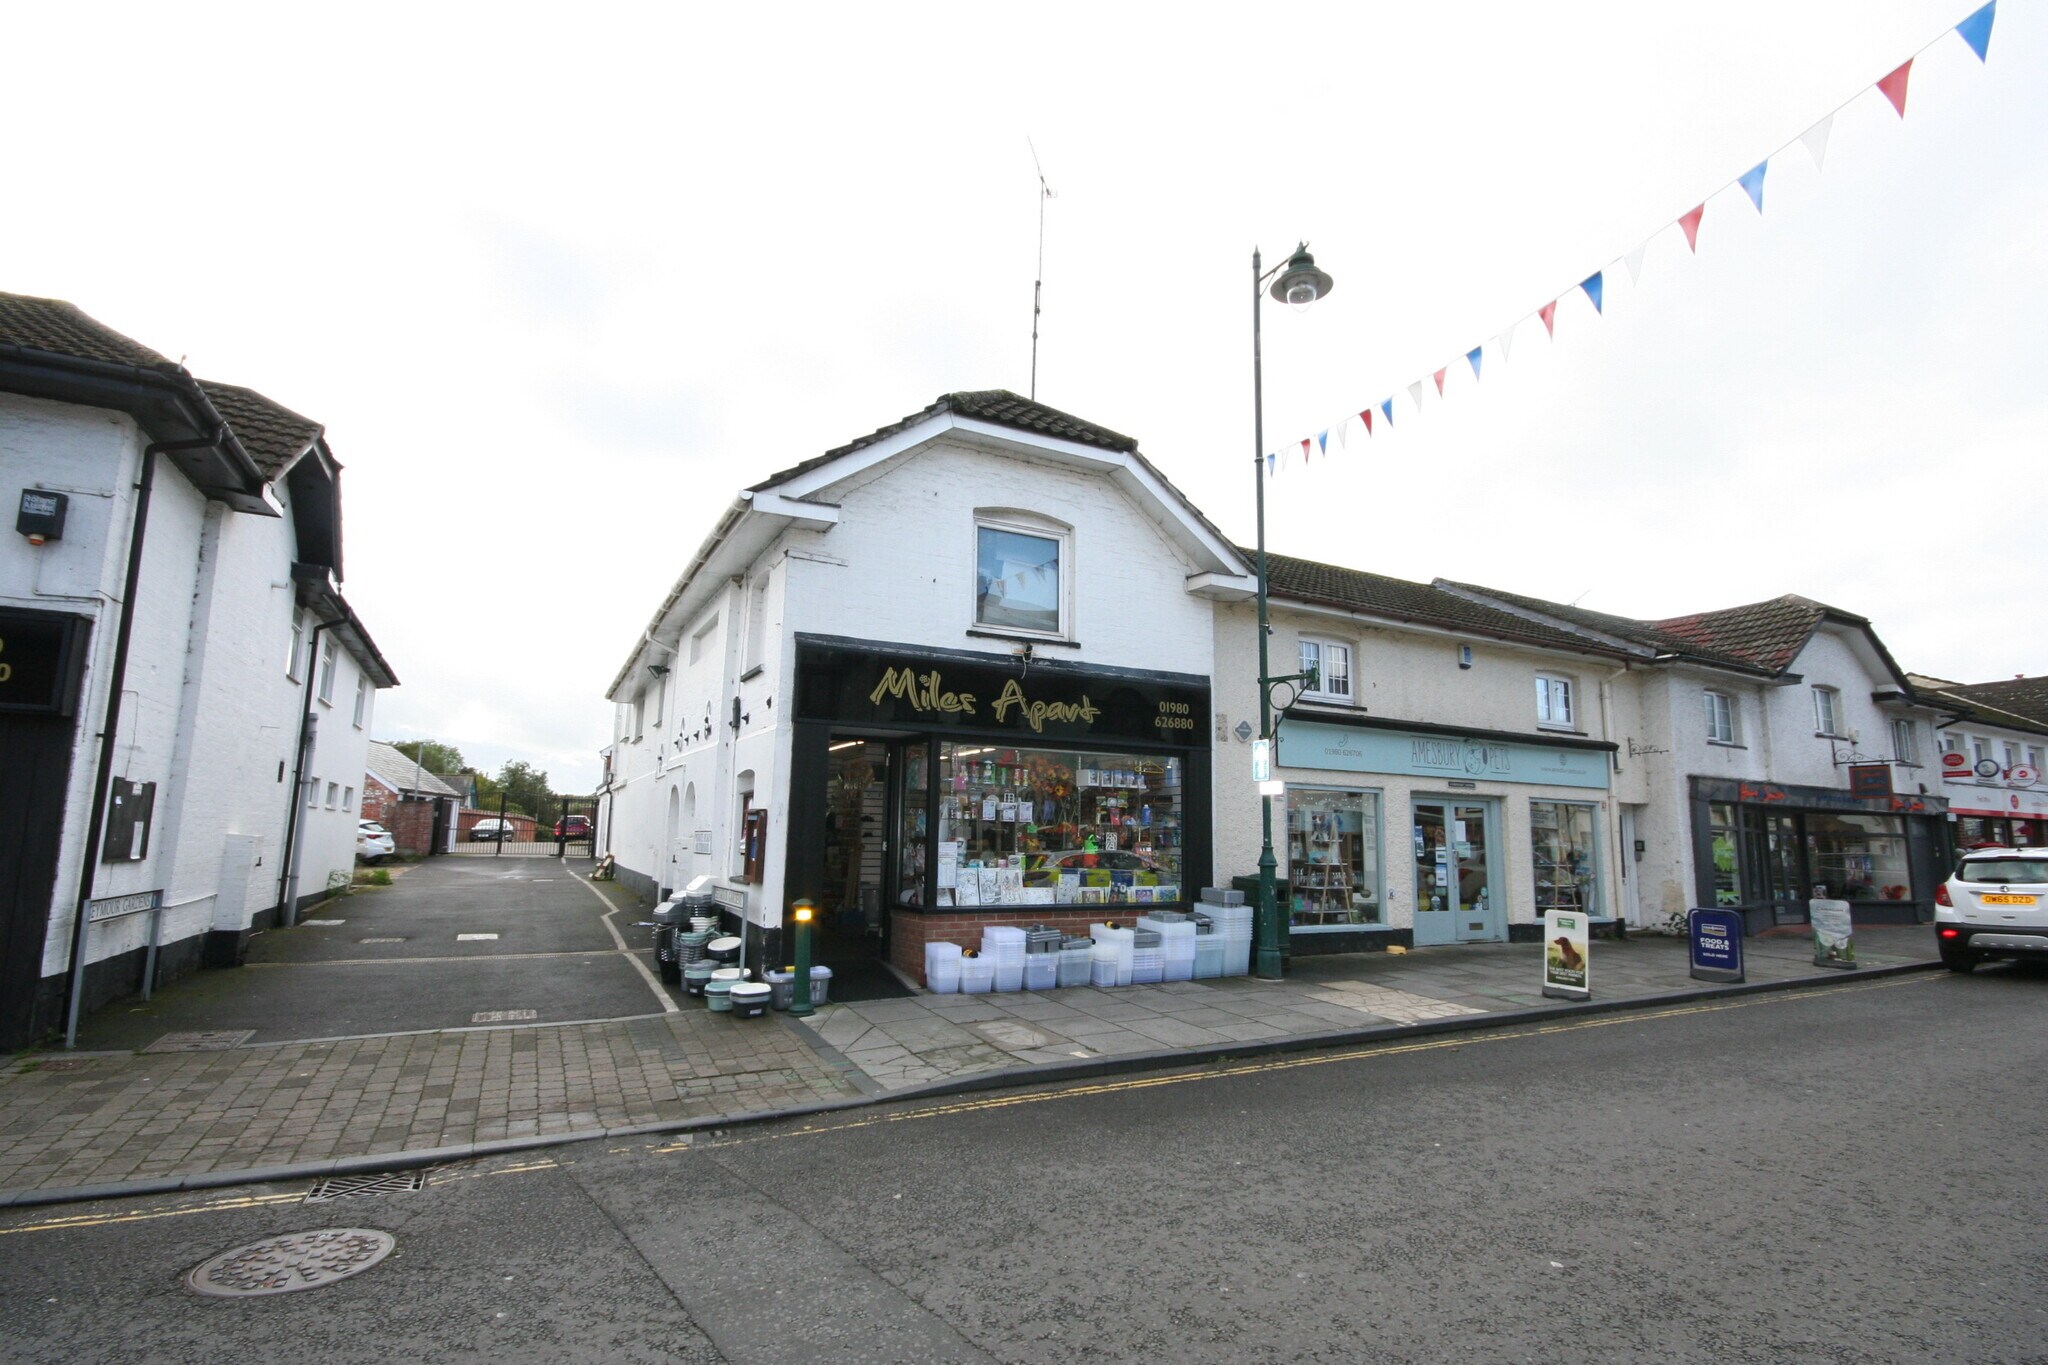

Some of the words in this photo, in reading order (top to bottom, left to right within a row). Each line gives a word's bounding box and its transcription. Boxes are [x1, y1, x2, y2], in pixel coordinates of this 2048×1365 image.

[870, 666, 976, 714] Miles
[992, 679, 1101, 734] Apart
[1159, 701, 1190, 715] 01980
[1155, 716, 1194, 730] 626880
[1411, 740, 1461, 767] AMESBURY
[1489, 747, 1511, 771] PETS
[91, 900, 120, 918] EYMOUR
[122, 894, 152, 911] GARDENS
[1700, 937, 1722, 945] FOOD
